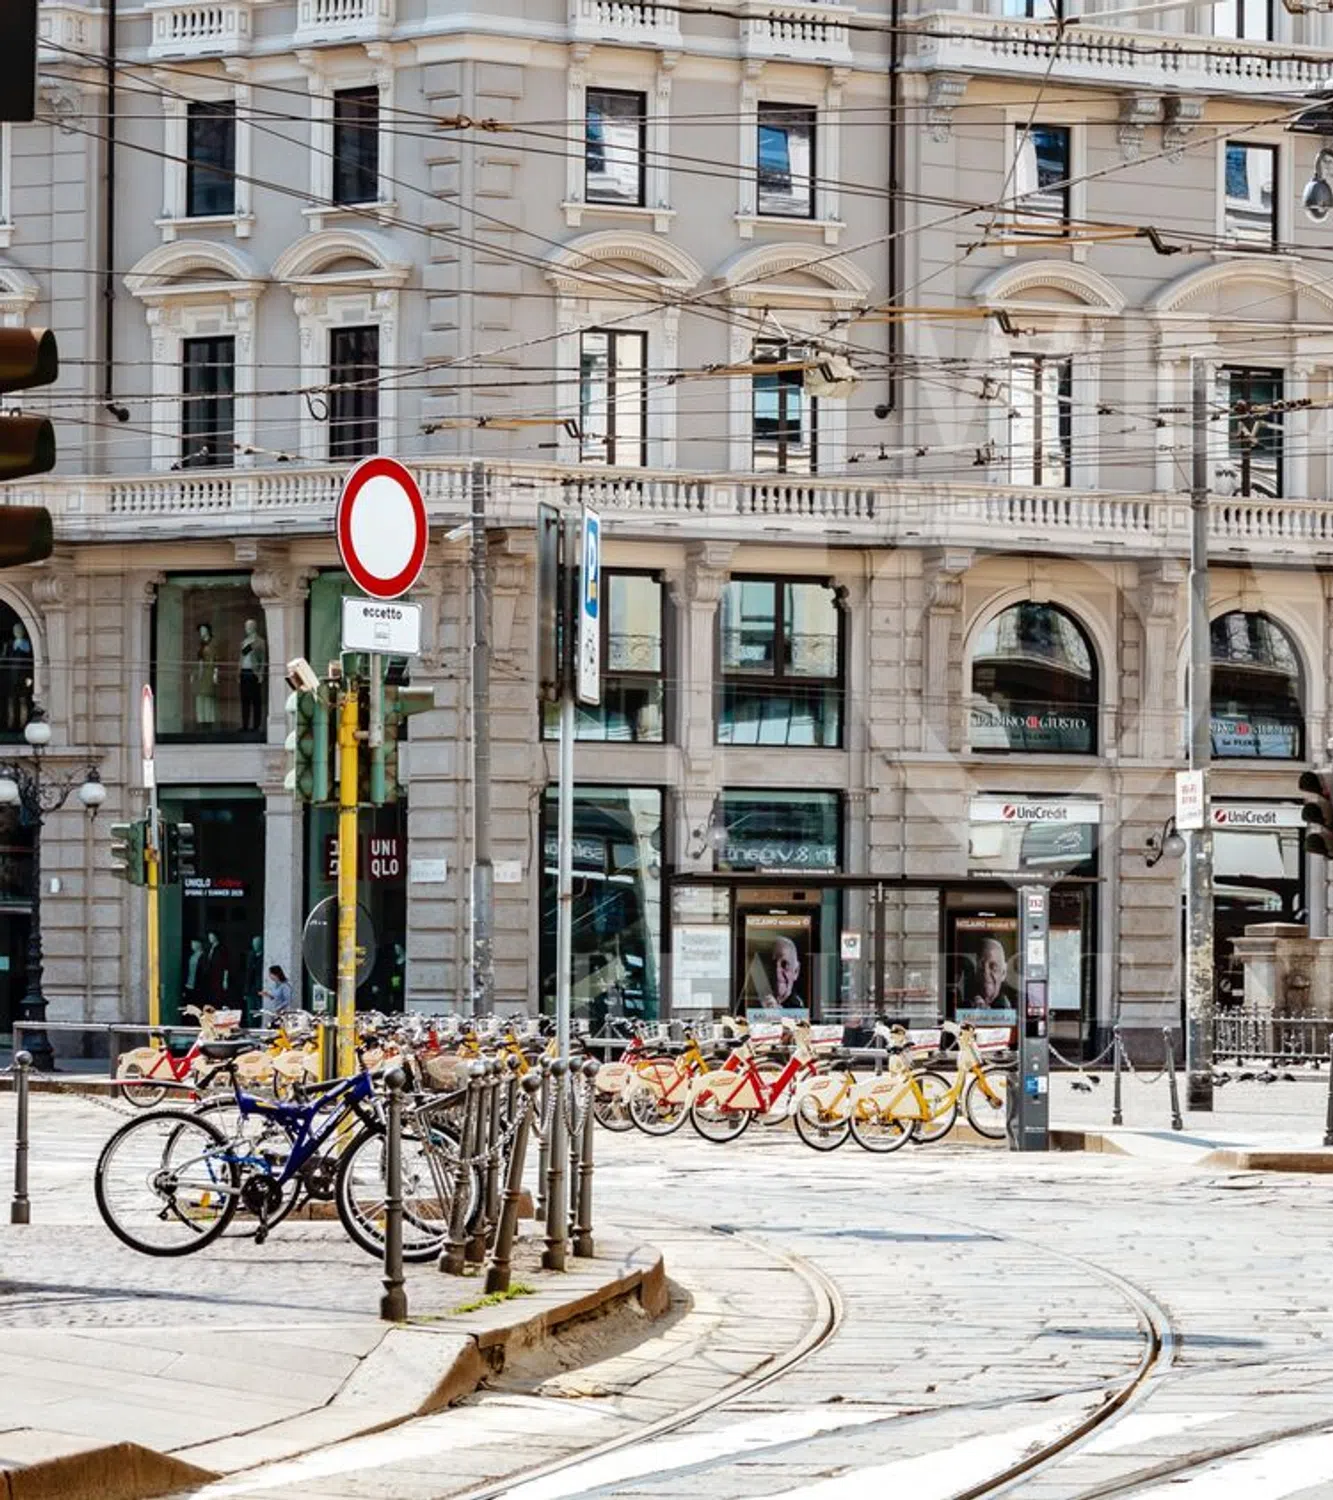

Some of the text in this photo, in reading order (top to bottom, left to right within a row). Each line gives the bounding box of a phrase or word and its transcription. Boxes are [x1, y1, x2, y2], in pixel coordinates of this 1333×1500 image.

[362, 607, 403, 620] eccetto
[1039, 715, 1087, 729] GIUSTO
[1016, 806, 1068, 820] UniCredit
[1228, 810, 1277, 824] UniCredit
[371, 840, 397, 856] UNI
[371, 858, 399, 878] QLO
[184, 878, 211, 888] UNIQLO
